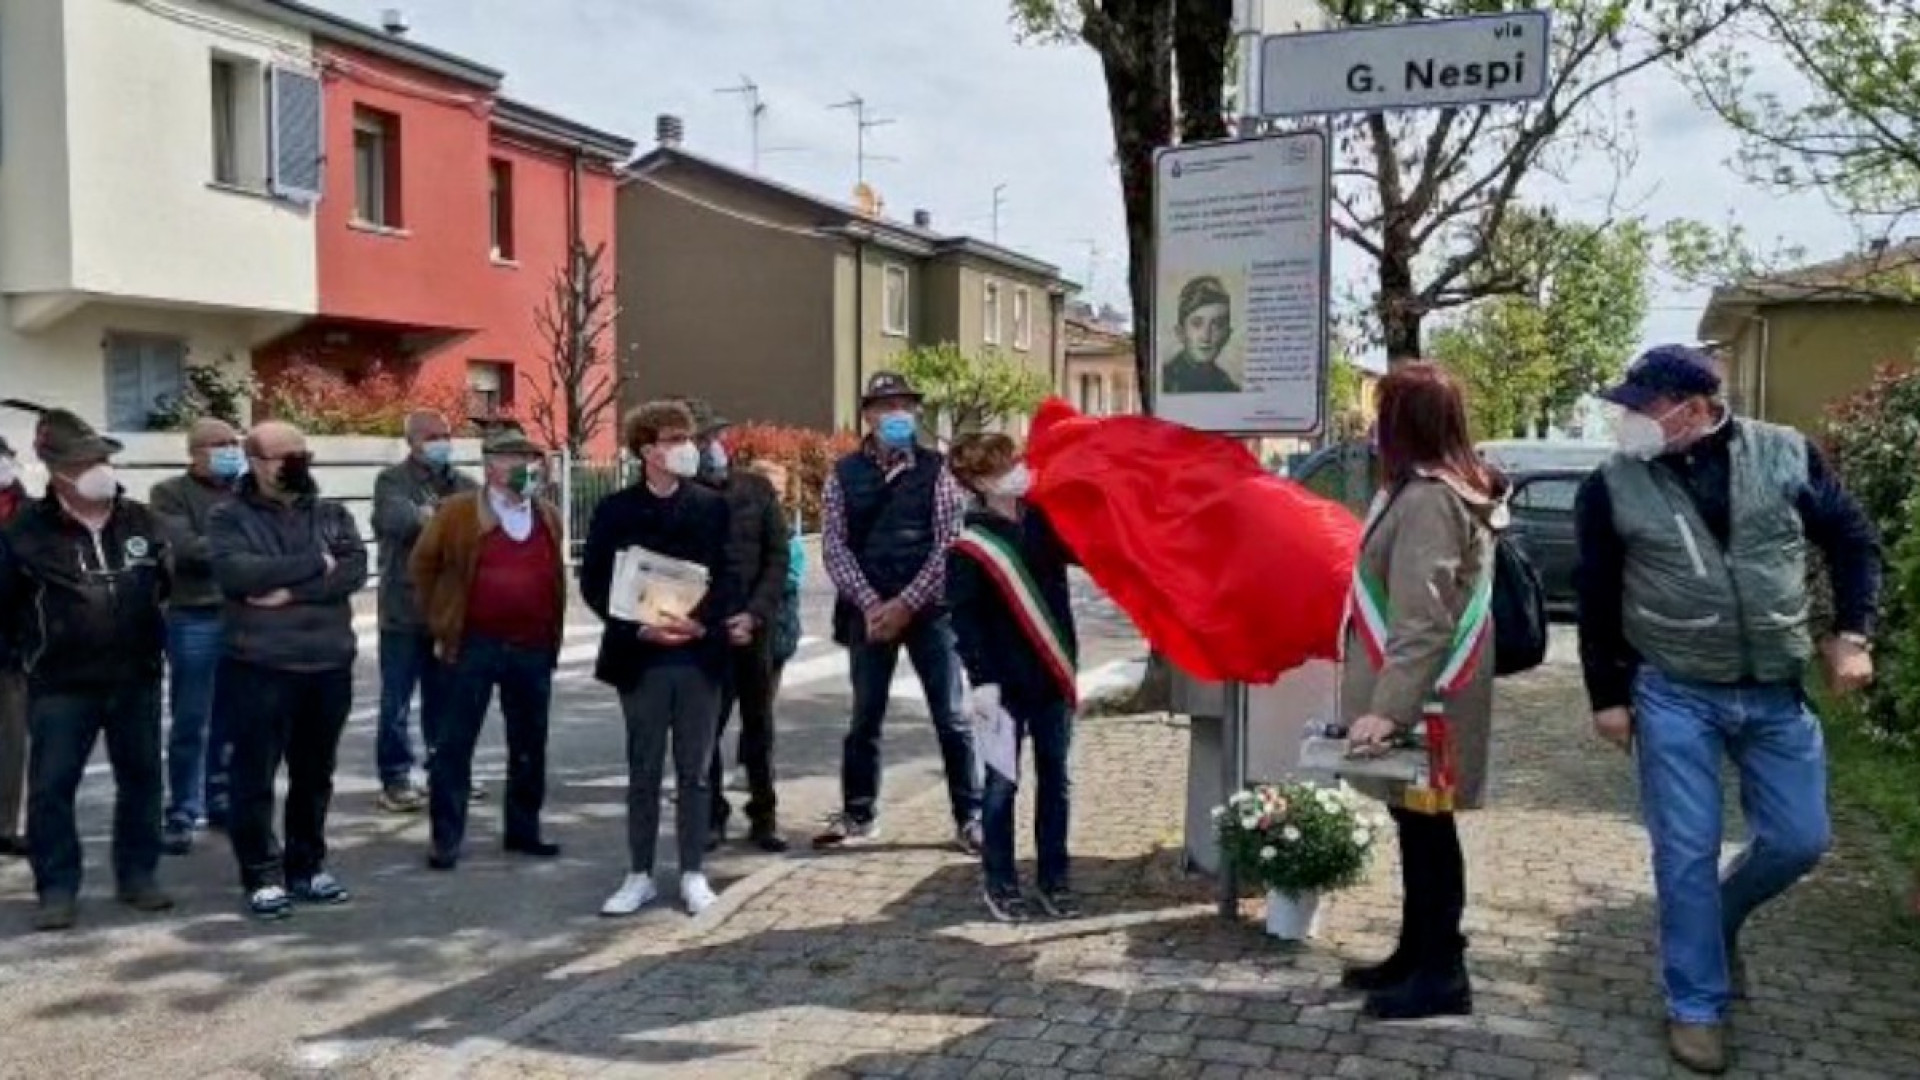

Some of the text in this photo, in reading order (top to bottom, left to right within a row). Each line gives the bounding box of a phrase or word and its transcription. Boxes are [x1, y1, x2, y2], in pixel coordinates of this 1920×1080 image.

[1494, 21, 1523, 40] via
[1346, 51, 1525, 92] G. Nespi
